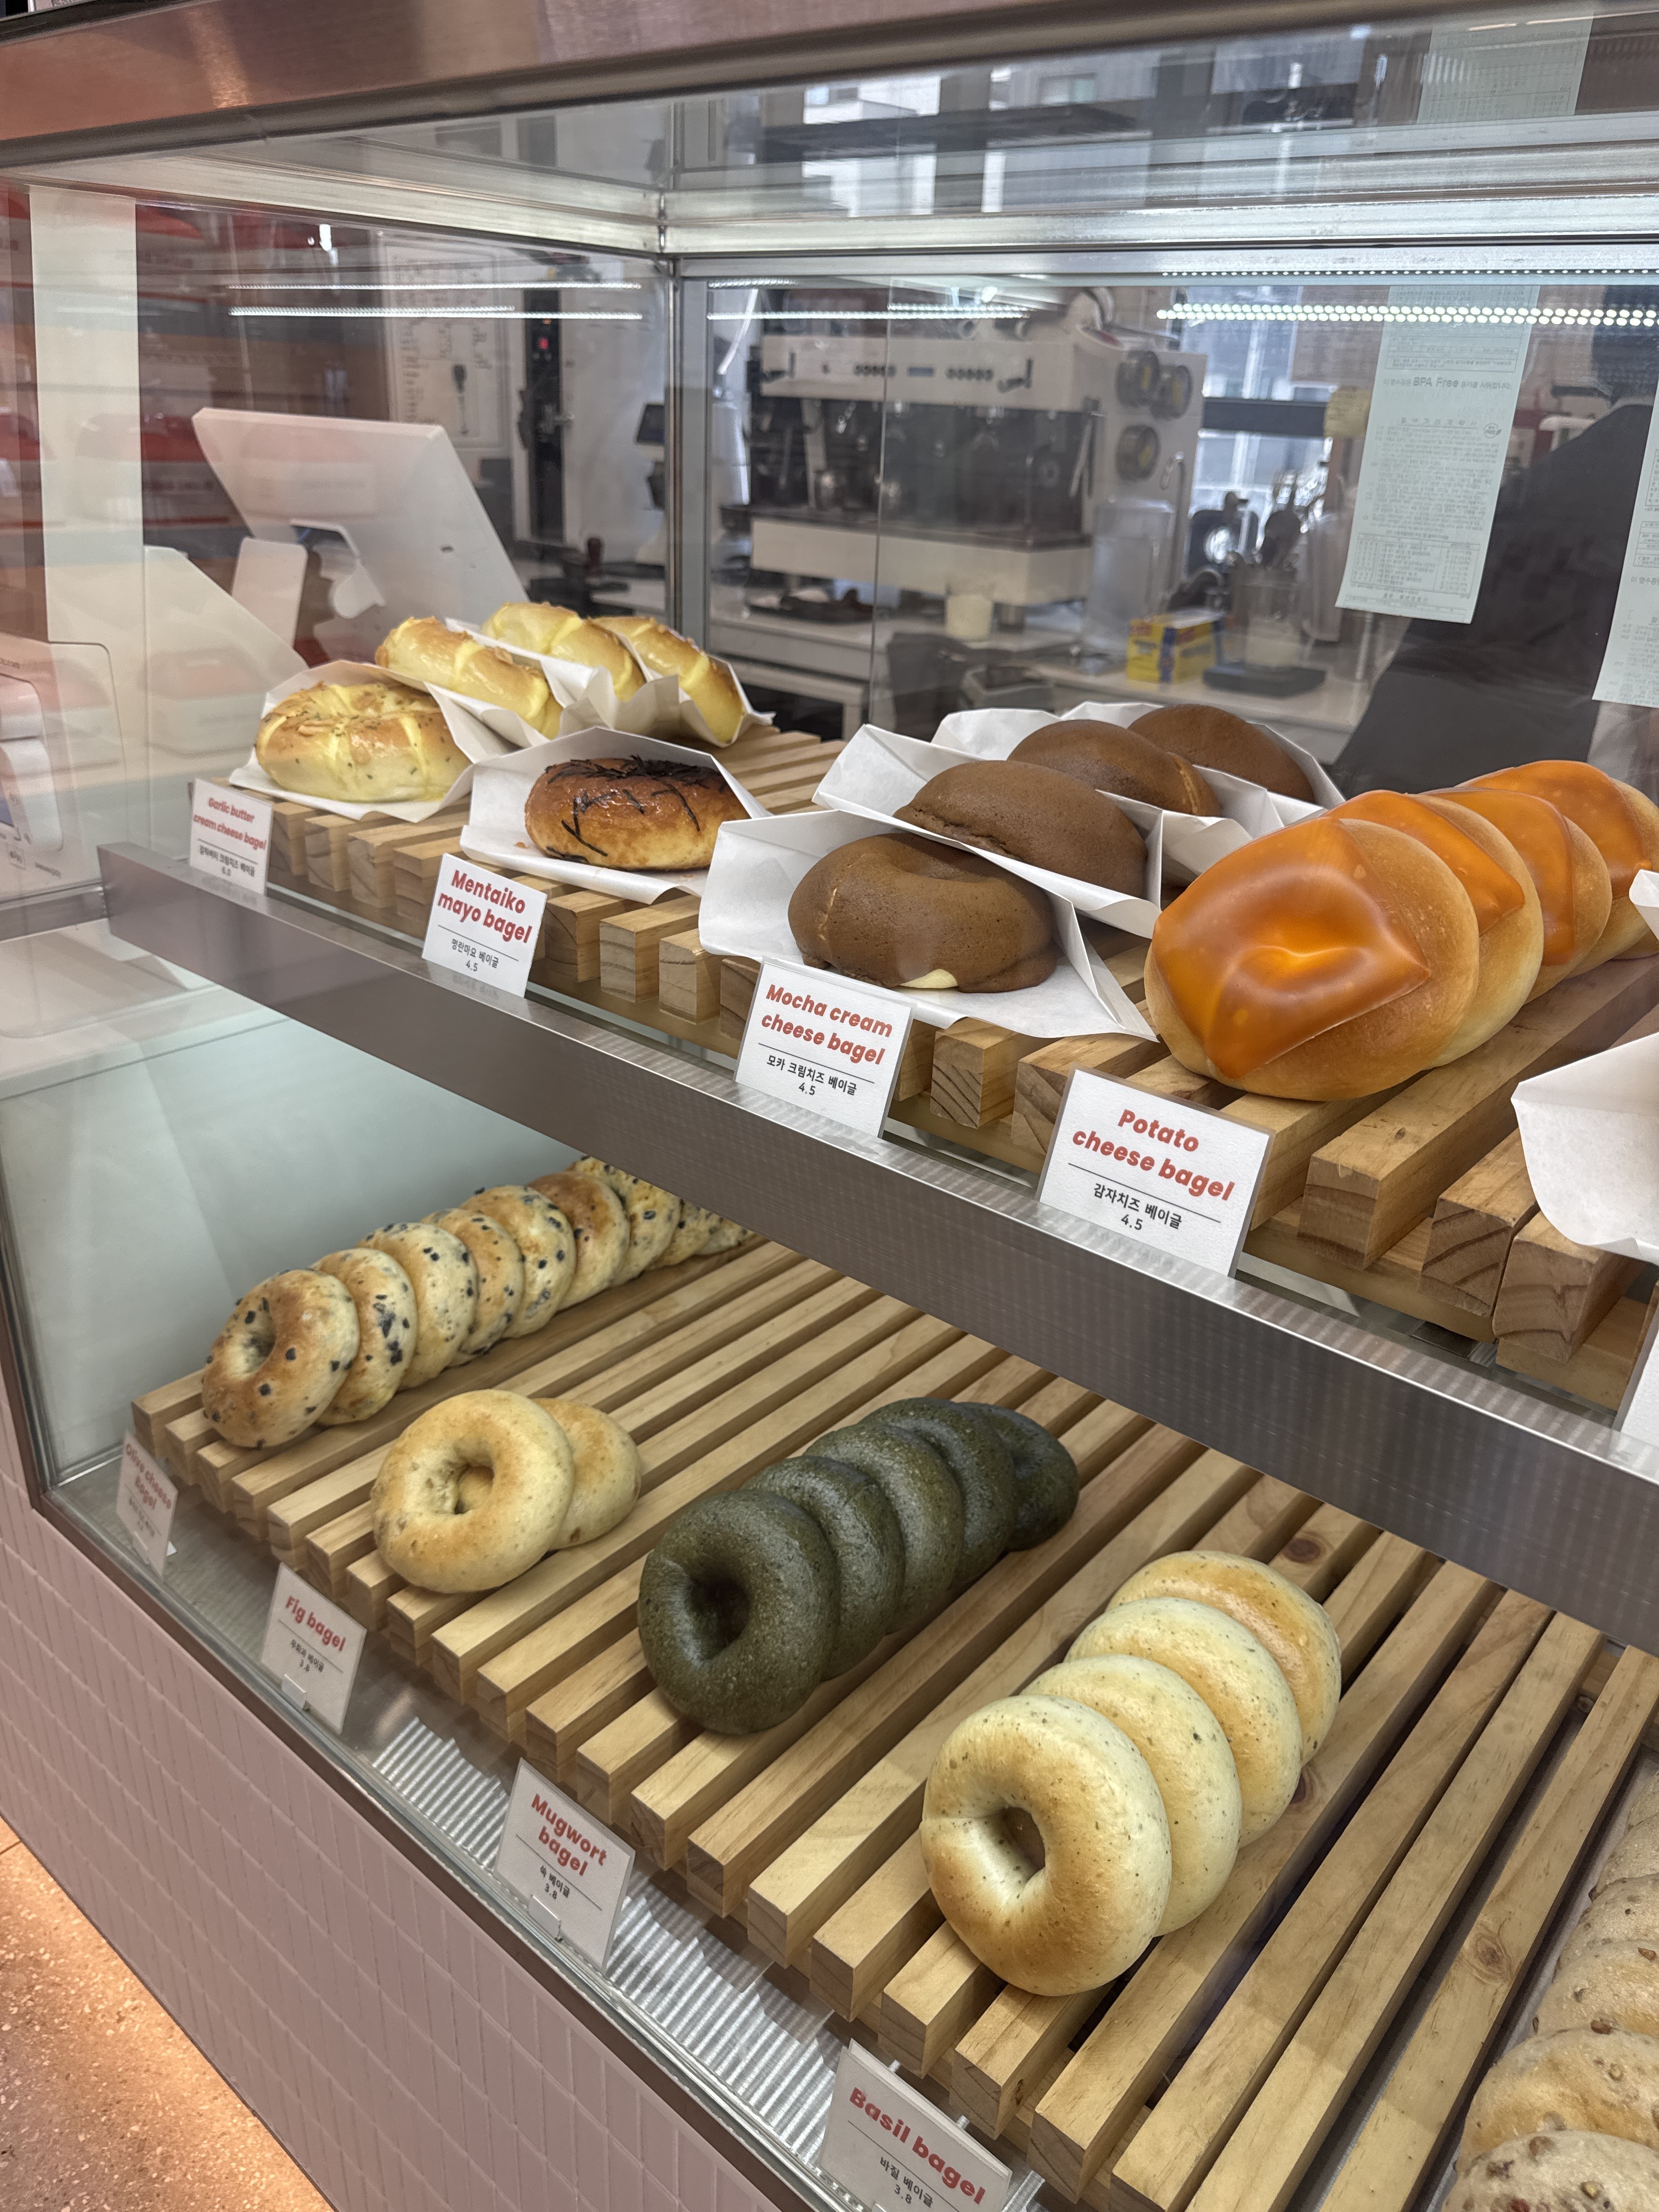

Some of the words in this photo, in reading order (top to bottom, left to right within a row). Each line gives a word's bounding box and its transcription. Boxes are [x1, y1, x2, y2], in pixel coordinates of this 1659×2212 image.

[1413, 377, 1432, 387] BPA
[1436, 377, 1458, 388] Free
[208, 797, 230, 814] Garlic
[230, 805, 255, 823] butter
[193, 814, 217, 830] cream
[217, 823, 244, 840] cheese
[244, 832, 267, 850] bagel
[451, 870, 526, 914] Mentaiko
[437, 893, 482, 922] mayo
[483, 909, 533, 943] bagel
[452, 938, 477, 958] 명란마요
[479, 951, 499, 969] 베이글
[466, 960, 478, 972] 4.5
[766, 984, 828, 1017] Mocha
[830, 1007, 893, 1037] cream
[761, 1014, 825, 1045] cheese
[827, 1032, 886, 1065] bagel
[766, 1054, 785, 1071] 모카
[787, 1062, 824, 1084] 크림치즈
[828, 1075, 857, 1096] 베이글
[799, 1082, 816, 1096] 4.5
[1118, 1109, 1199, 1152] Potato
[1072, 1130, 1155, 1171] cheese
[1158, 1158, 1235, 1201] bagel
[1093, 1183, 1141, 1212] 감자치즈
[1144, 1204, 1182, 1229] 베이글
[1121, 1214, 1143, 1231] 4.5
[145, 1469, 172, 1510] cheese
[285, 1595, 306, 1623] Fig
[307, 1611, 347, 1652] bagel
[308, 1654, 325, 1672] 베이글
[531, 1793, 607, 1866] Mugwort
[538, 1826, 589, 1877] bagel
[539, 1864, 548, 1878] 쑥
[549, 1874, 571, 1899] 베이글
[544, 1884, 557, 1900] 3.8
[849, 2087, 912, 2143] Basil
[912, 2135, 986, 2205] bagel
[880, 2157, 900, 2181] 바질
[903, 2175, 933, 2208] 베이글
[894, 2183, 912, 2204] 3.8
